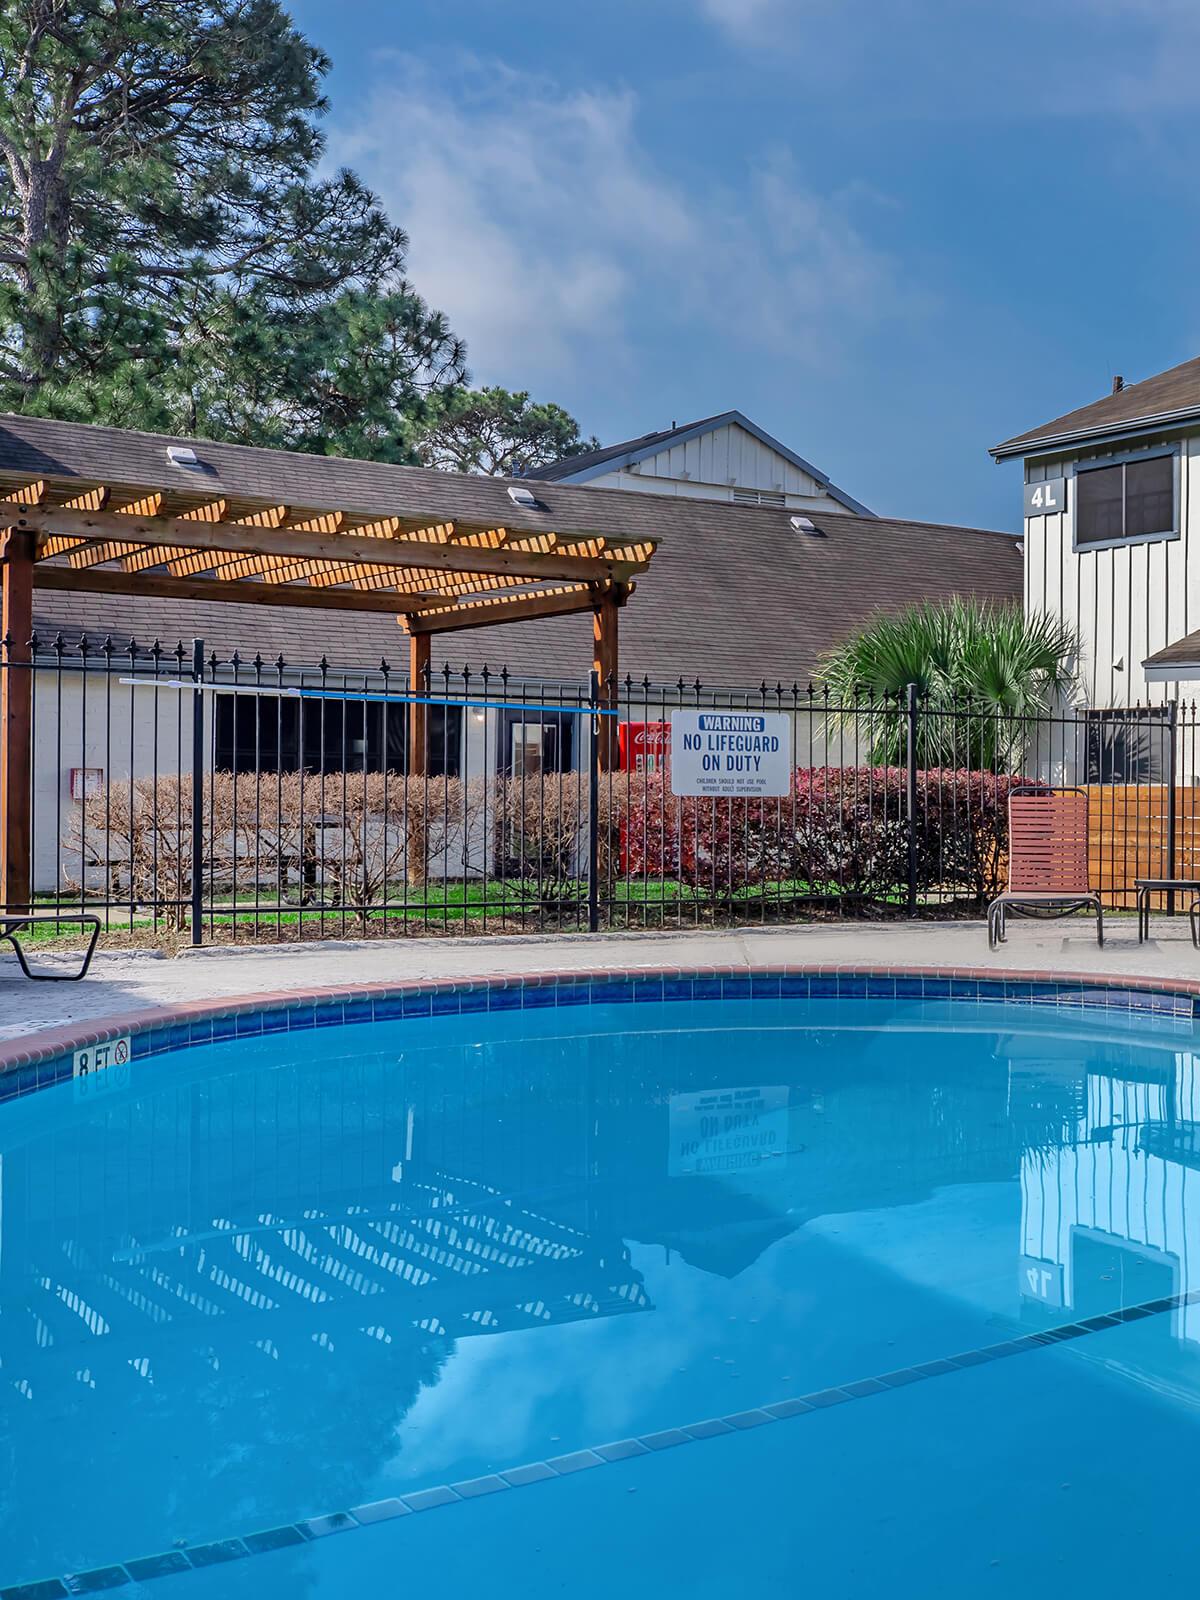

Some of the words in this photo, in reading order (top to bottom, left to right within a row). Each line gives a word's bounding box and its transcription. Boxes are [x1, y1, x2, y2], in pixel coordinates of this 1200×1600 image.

[1031, 485, 1056, 507] 4L
[703, 716, 761, 731] WARNING
[683, 734, 701, 751] NO
[708, 734, 779, 752] LIFEGUARD
[702, 754, 720, 771] ON
[726, 755, 761, 772] DUTY
[80, 1053, 88, 1076] 8
[96, 1046, 110, 1072] FT
